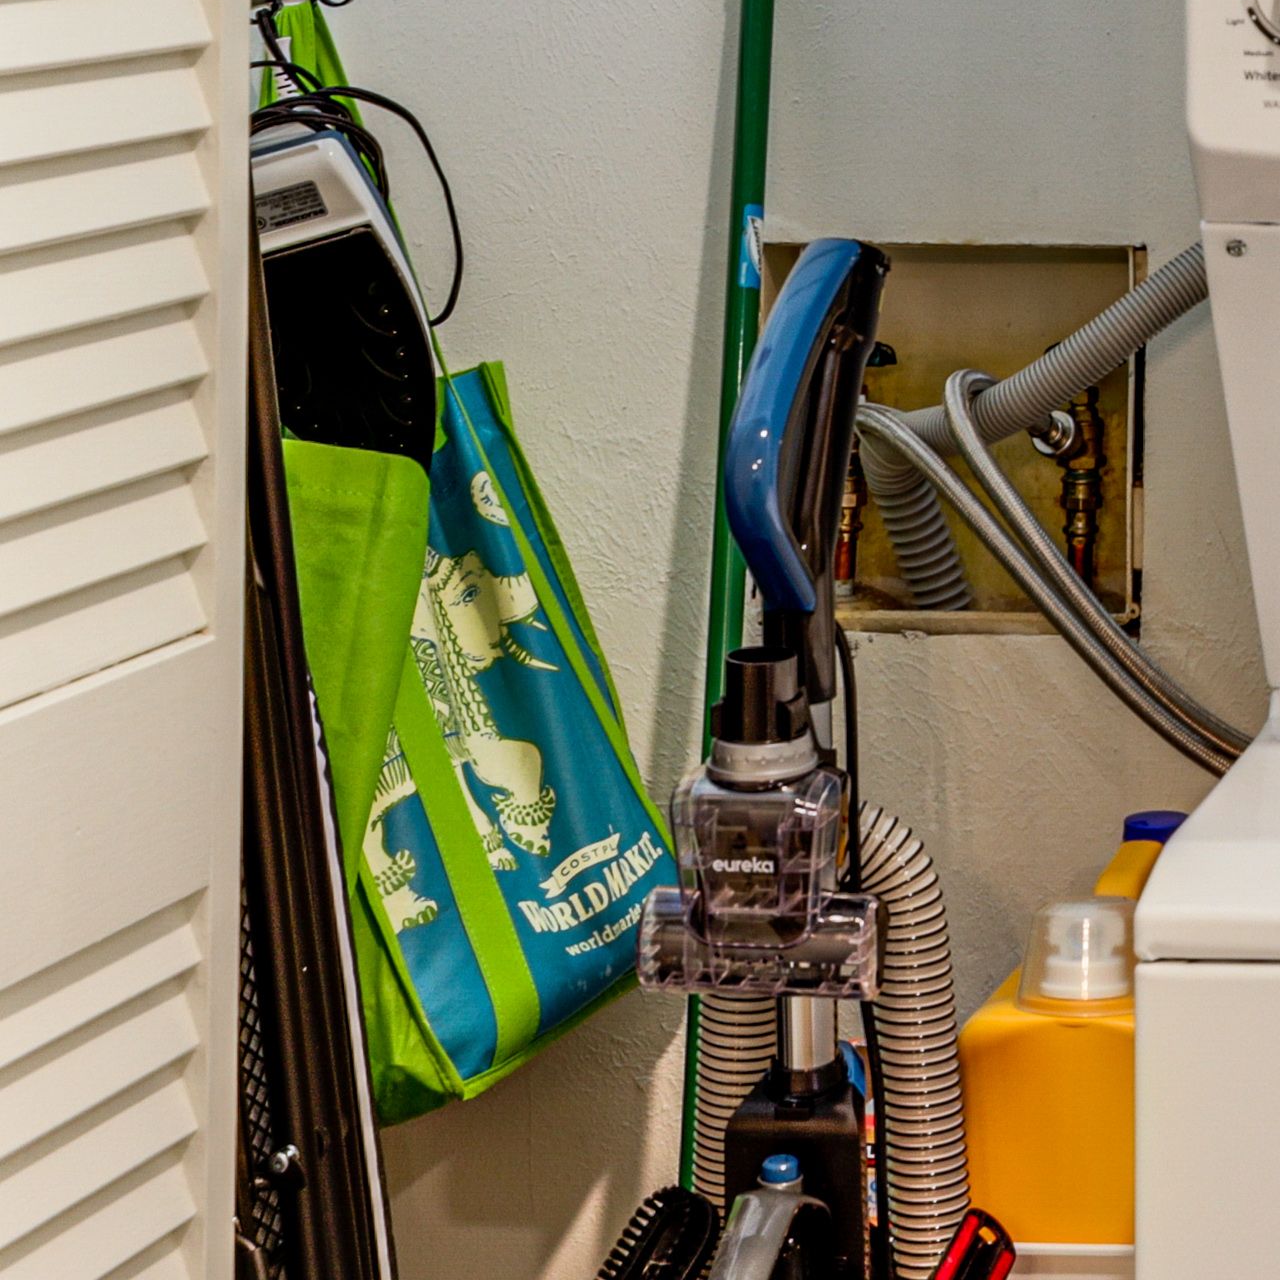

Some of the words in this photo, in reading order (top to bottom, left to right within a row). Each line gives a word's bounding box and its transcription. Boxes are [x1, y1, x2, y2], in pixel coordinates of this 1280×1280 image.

[560, 848, 602, 877] COST
[712, 856, 774, 874] eureka
[518, 881, 609, 933] WORLD
